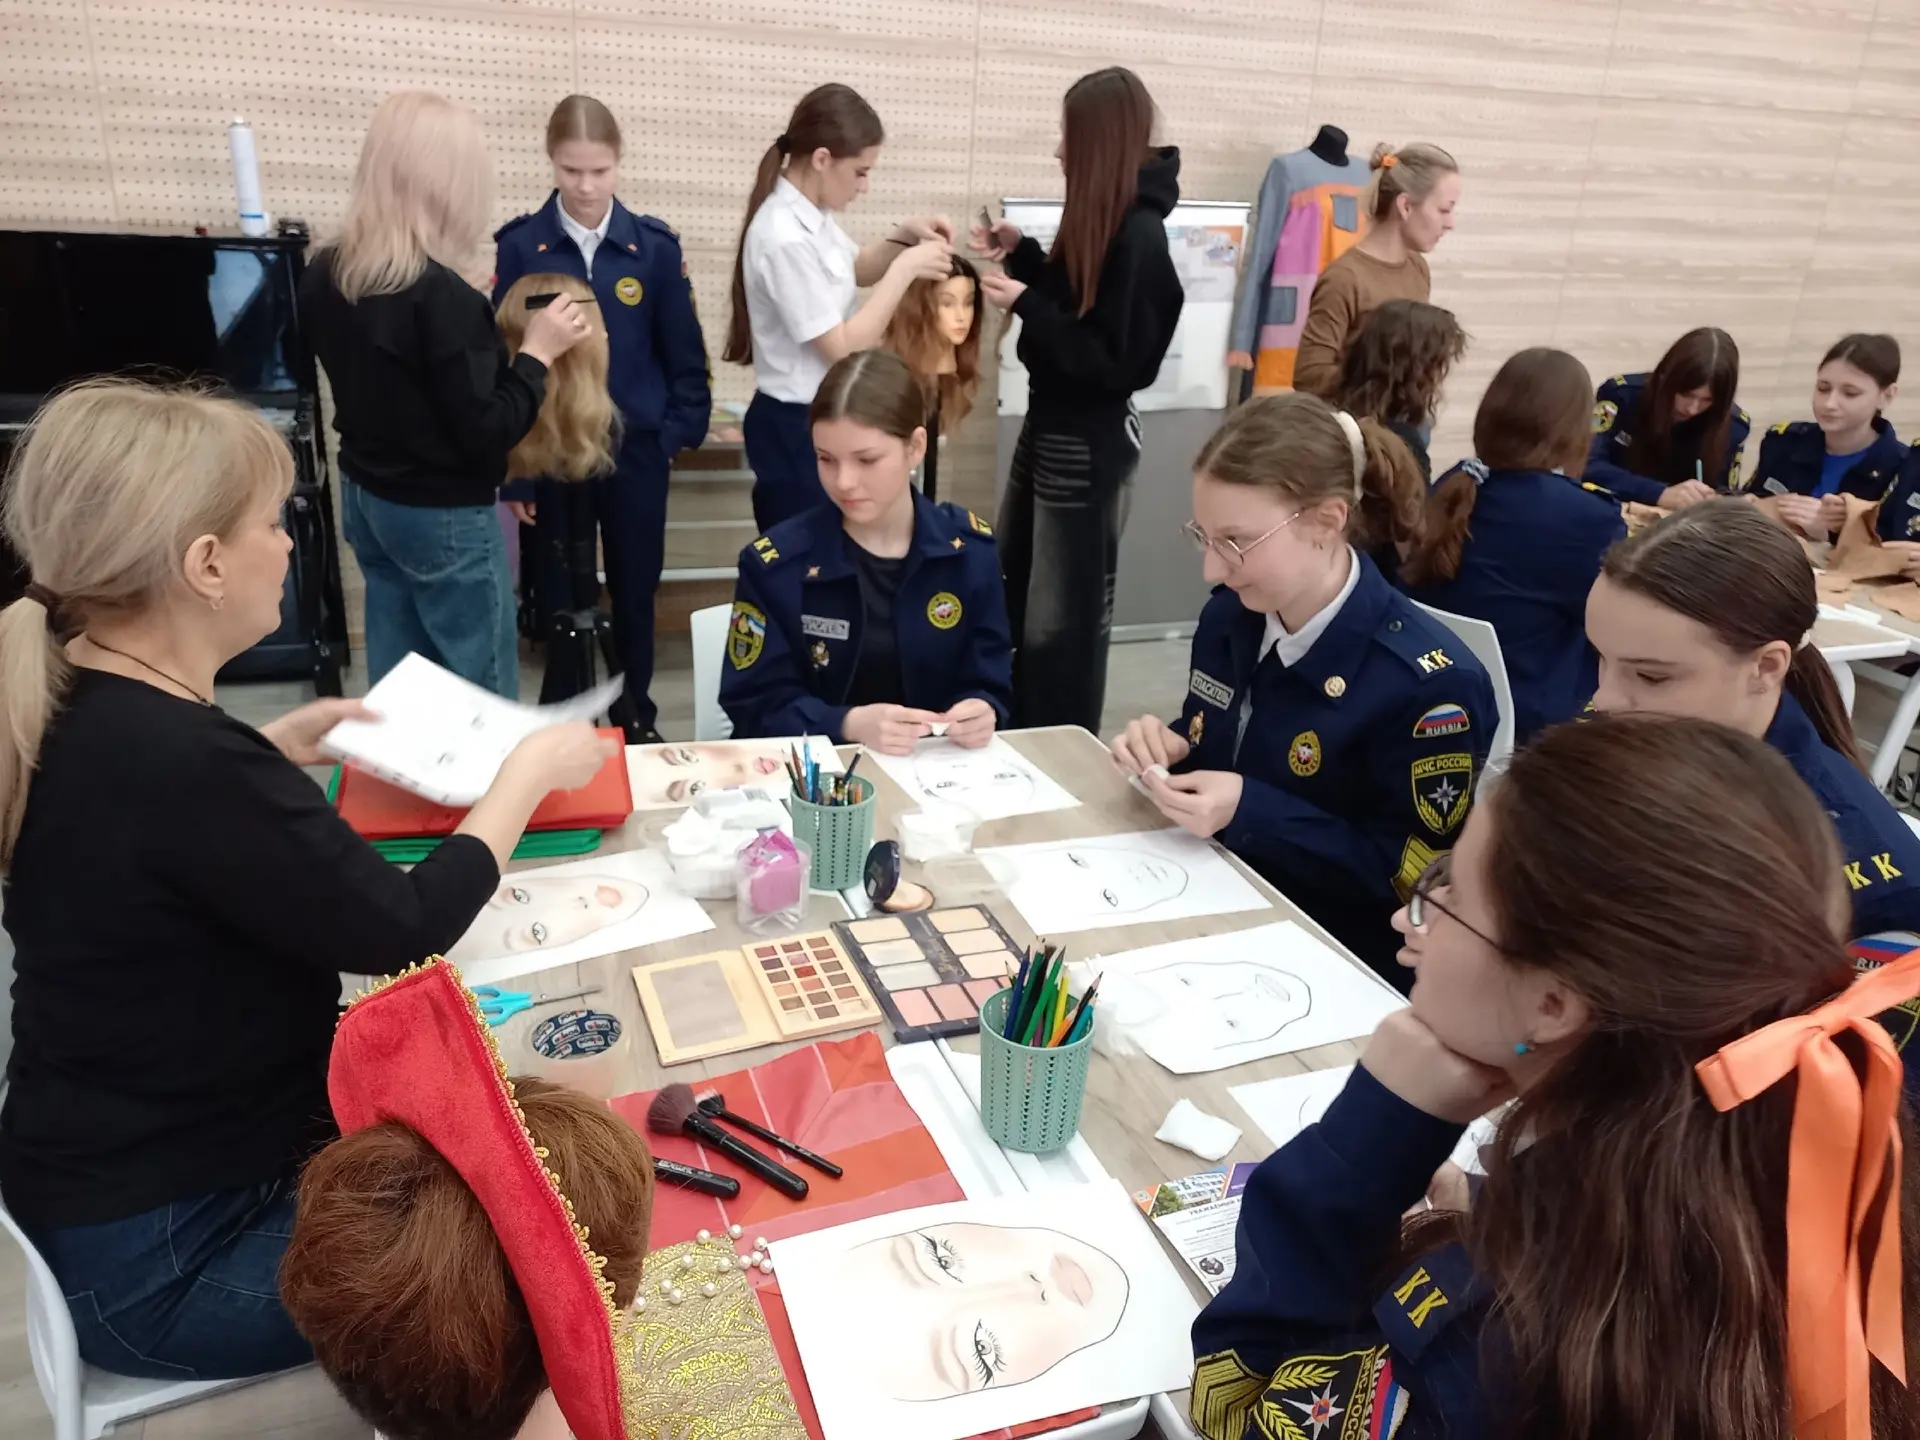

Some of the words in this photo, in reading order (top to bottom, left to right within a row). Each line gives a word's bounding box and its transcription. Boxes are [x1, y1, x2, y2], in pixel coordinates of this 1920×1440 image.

[1416, 648, 1453, 673] КК
[1426, 722, 1462, 737] RUSSIA
[1414, 761, 1436, 775] МЧС
[1436, 757, 1471, 770] РОССИИ
[1393, 1266, 1449, 1329] КК
